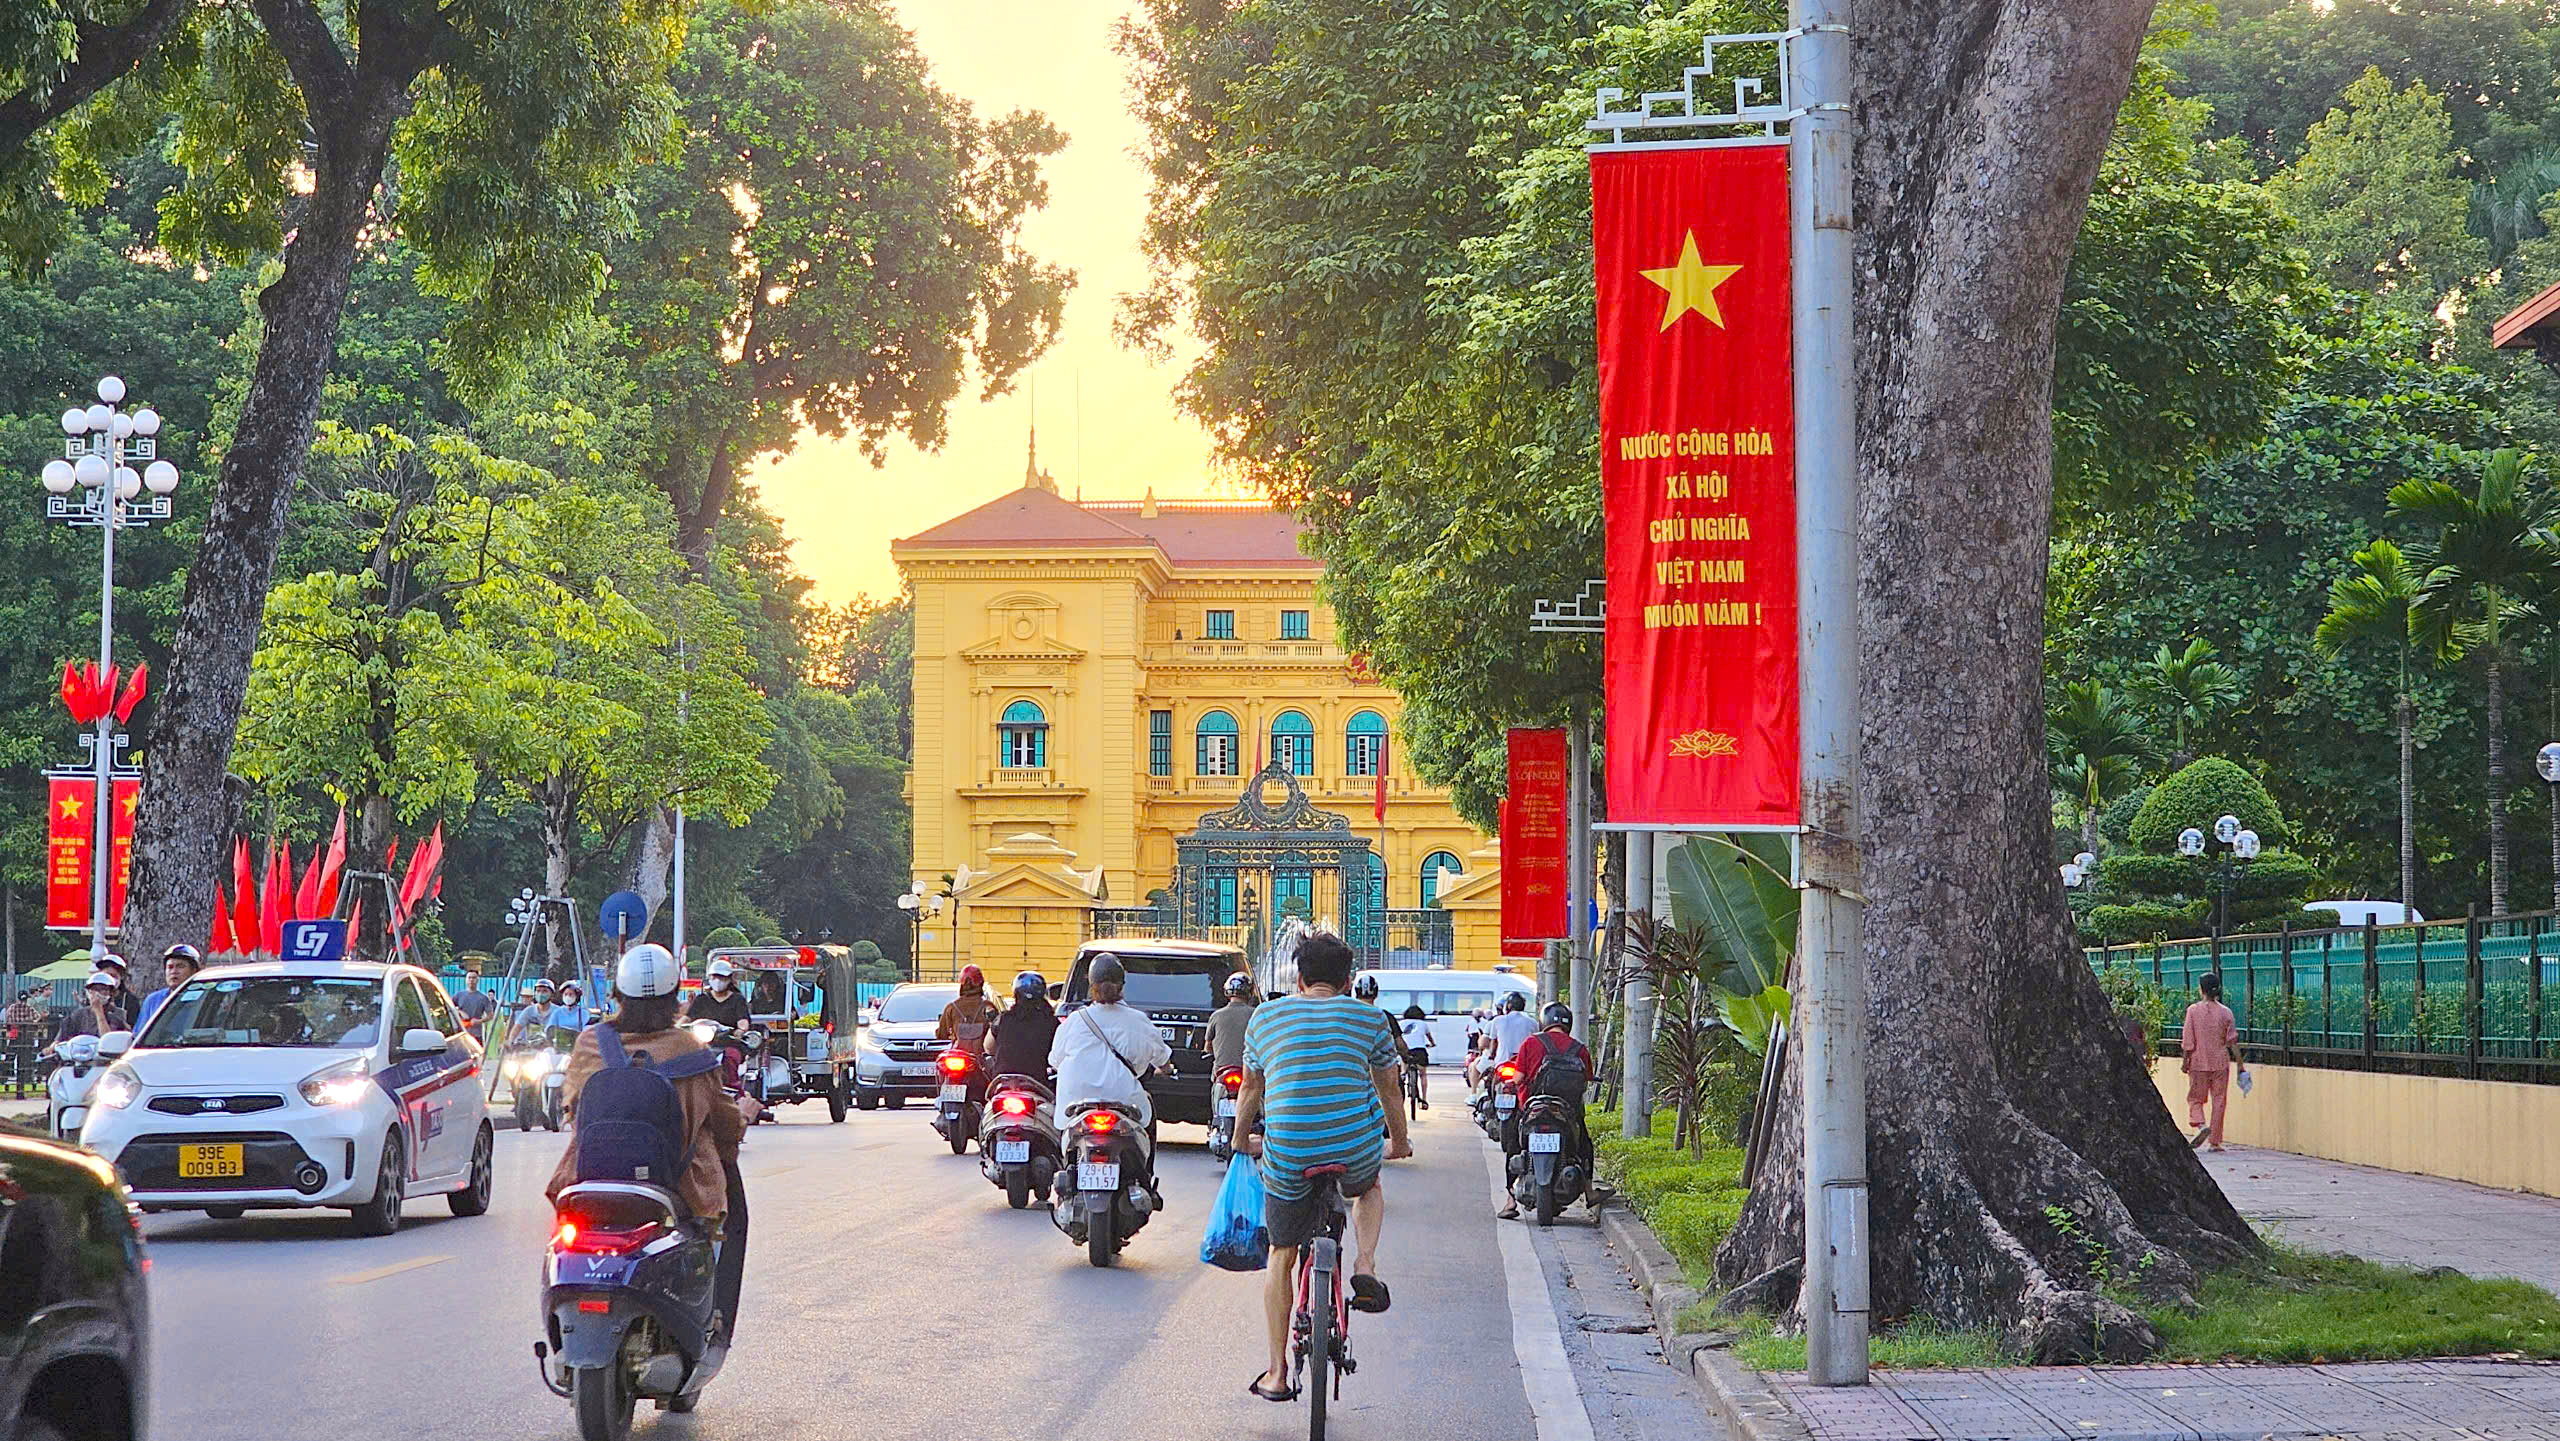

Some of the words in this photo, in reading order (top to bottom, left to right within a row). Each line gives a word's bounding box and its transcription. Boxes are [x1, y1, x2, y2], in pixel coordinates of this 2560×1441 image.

[1620, 431, 1671, 460] NƯỚC
[1676, 428, 1728, 460] CỘNG
[1734, 427, 1773, 455] HÒA
[1666, 471, 1691, 499] XÃ
[1696, 470, 1728, 502] HỘI
[1650, 511, 1685, 543] CHỦ
[1691, 513, 1750, 541] NGHĨA
[1656, 557, 1694, 589] VIỆT
[1700, 560, 1744, 583] NAM
[1644, 600, 1699, 629] MUÔN
[1704, 598, 1749, 626] NĂM
[296, 925, 329, 957] G7
[204, 1100, 223, 1109] KIA
[186, 1161, 237, 1175] 009.83
[198, 1146, 225, 1160] 99E
[1081, 1176, 1116, 1188] 511.57
[1085, 1164, 1112, 1176] 29-C1
